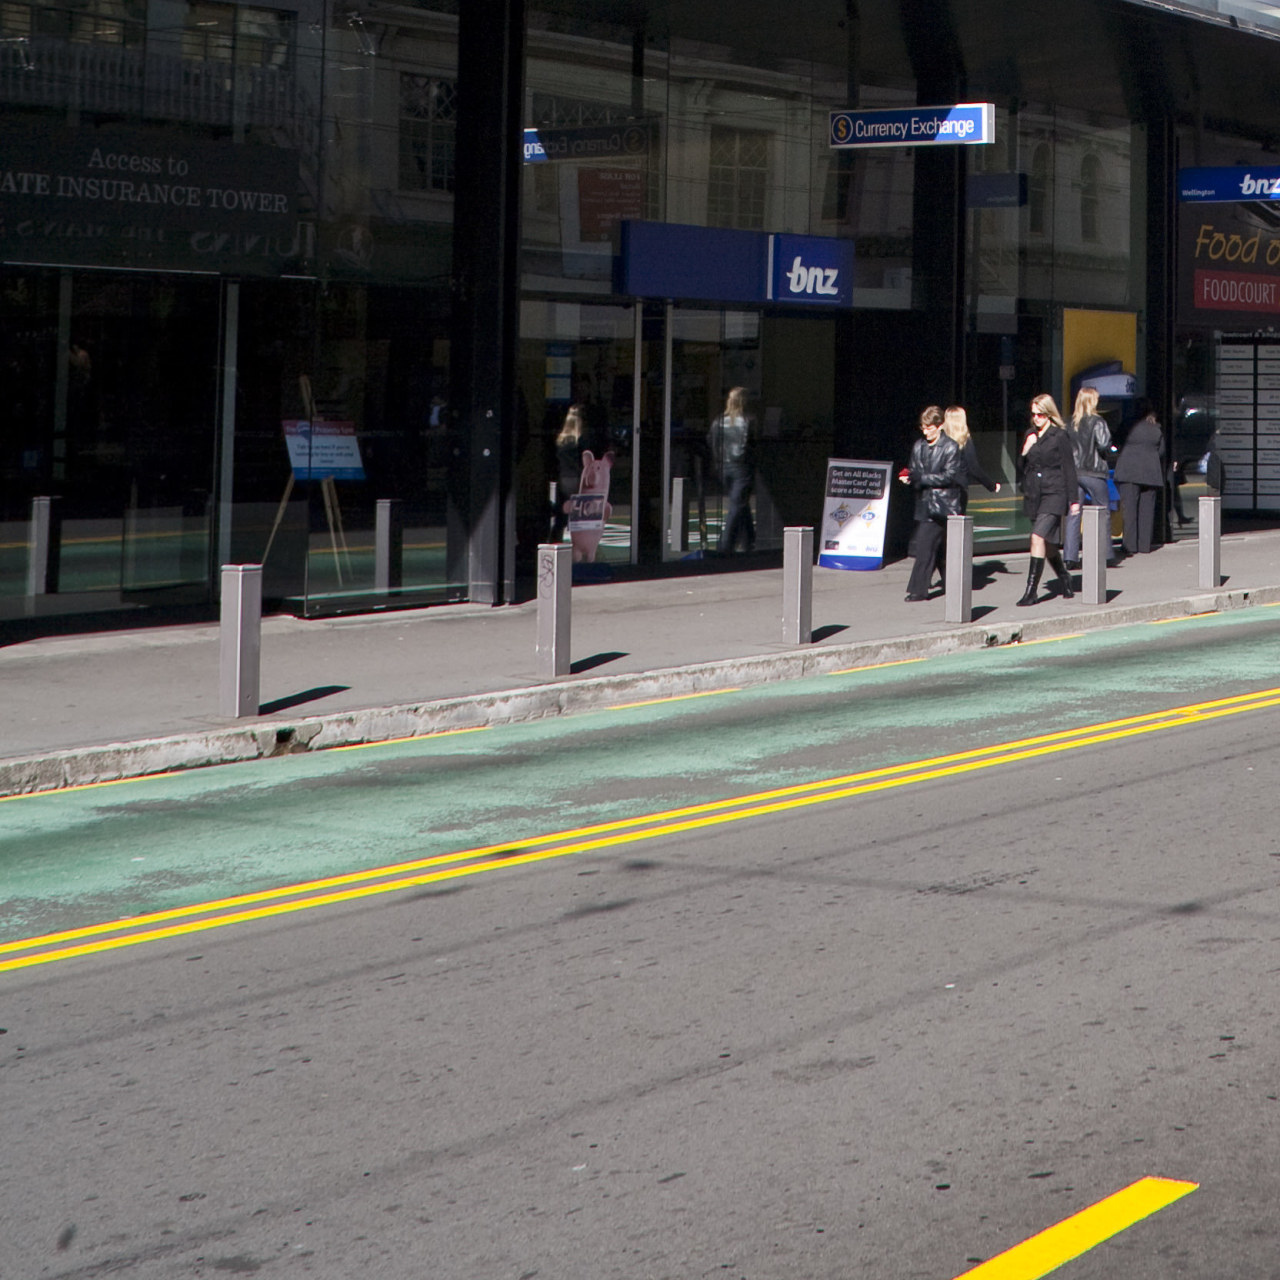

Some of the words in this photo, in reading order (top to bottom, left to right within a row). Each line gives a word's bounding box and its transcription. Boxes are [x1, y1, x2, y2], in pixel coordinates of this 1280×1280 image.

[855, 119, 908, 139] Currency
[911, 116, 975, 137] Exchange
[88, 147, 162, 175] Access
[168, 157, 189, 177] to
[0, 170, 51, 197] ATE
[56, 174, 201, 207] INSURANCE
[206, 188, 289, 214] TOWER
[1181, 188, 1216, 198] Wellington
[1194, 223, 1263, 264] Food
[785, 255, 839, 295] bnz
[1203, 277, 1278, 306] FOODCOURT
